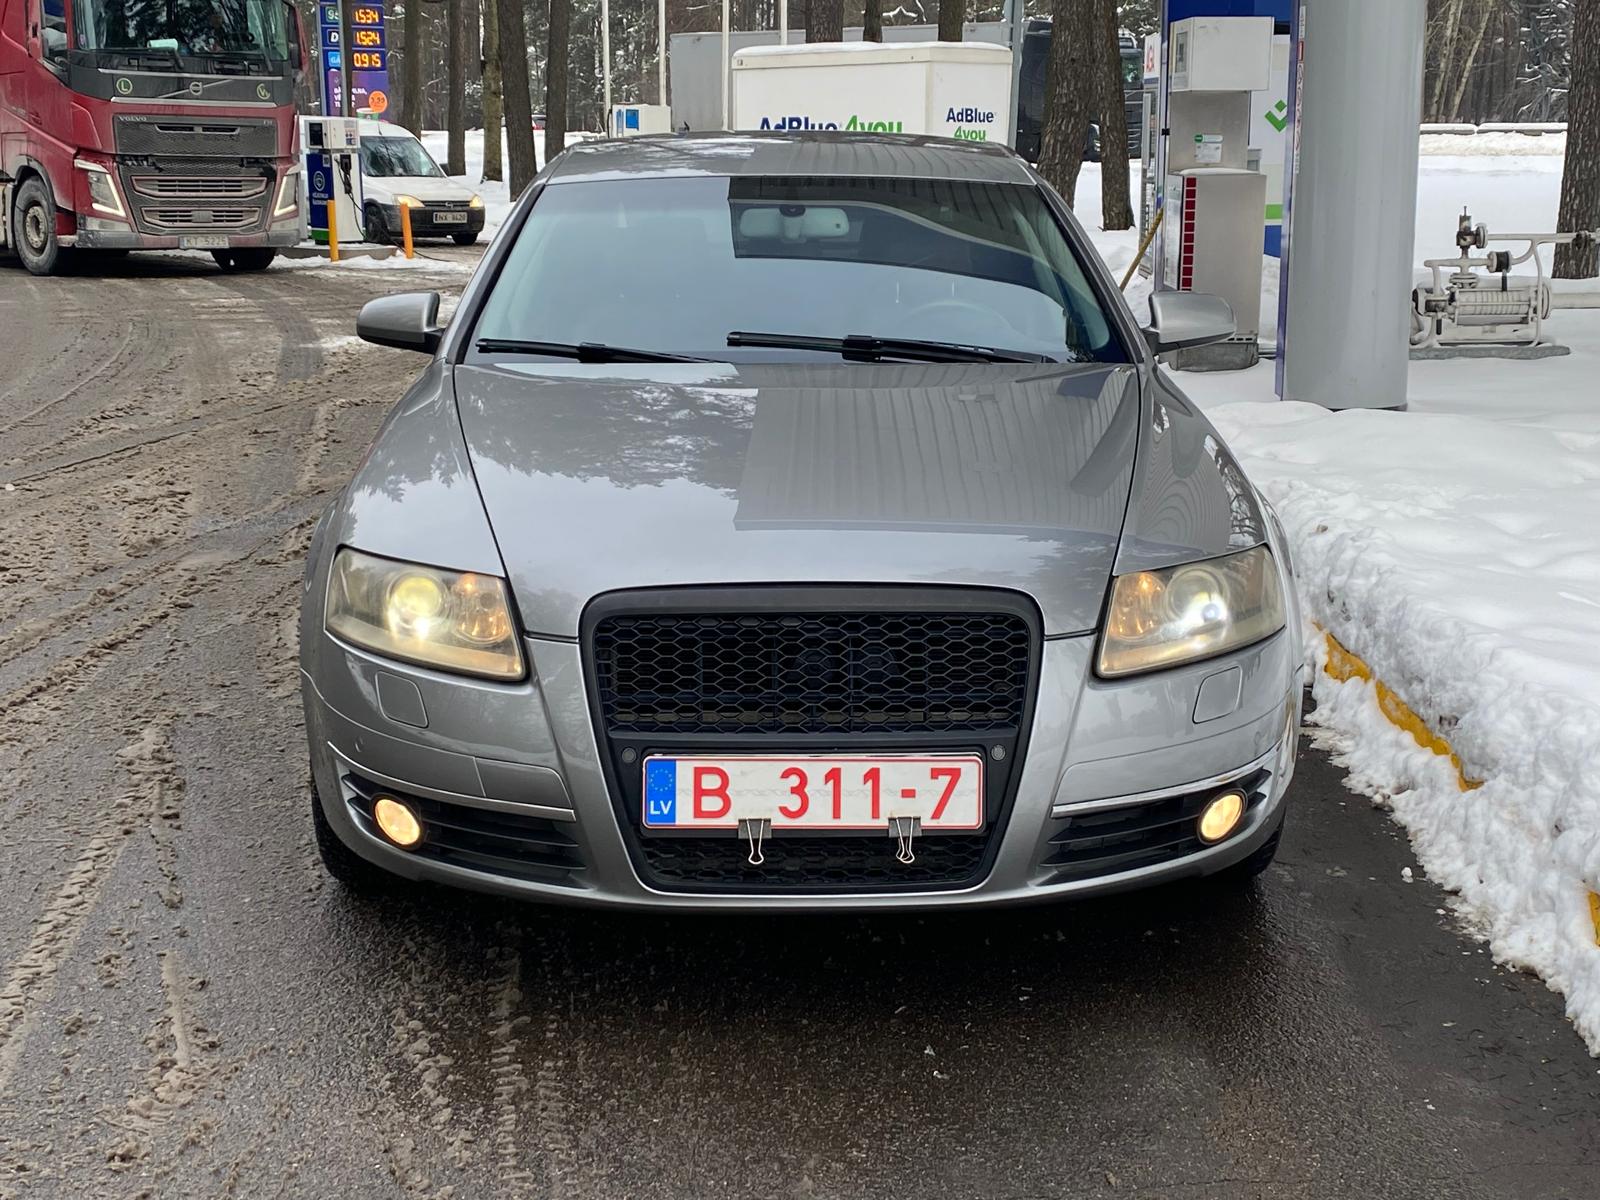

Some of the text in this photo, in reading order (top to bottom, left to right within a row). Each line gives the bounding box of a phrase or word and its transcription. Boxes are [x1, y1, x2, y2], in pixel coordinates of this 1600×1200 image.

[330, 31, 339, 43] D
[946, 107, 994, 123] AdBlue
[953, 125, 986, 141] 4you
[693, 766, 962, 820] B 311-7
[649, 800, 673, 816] LV
